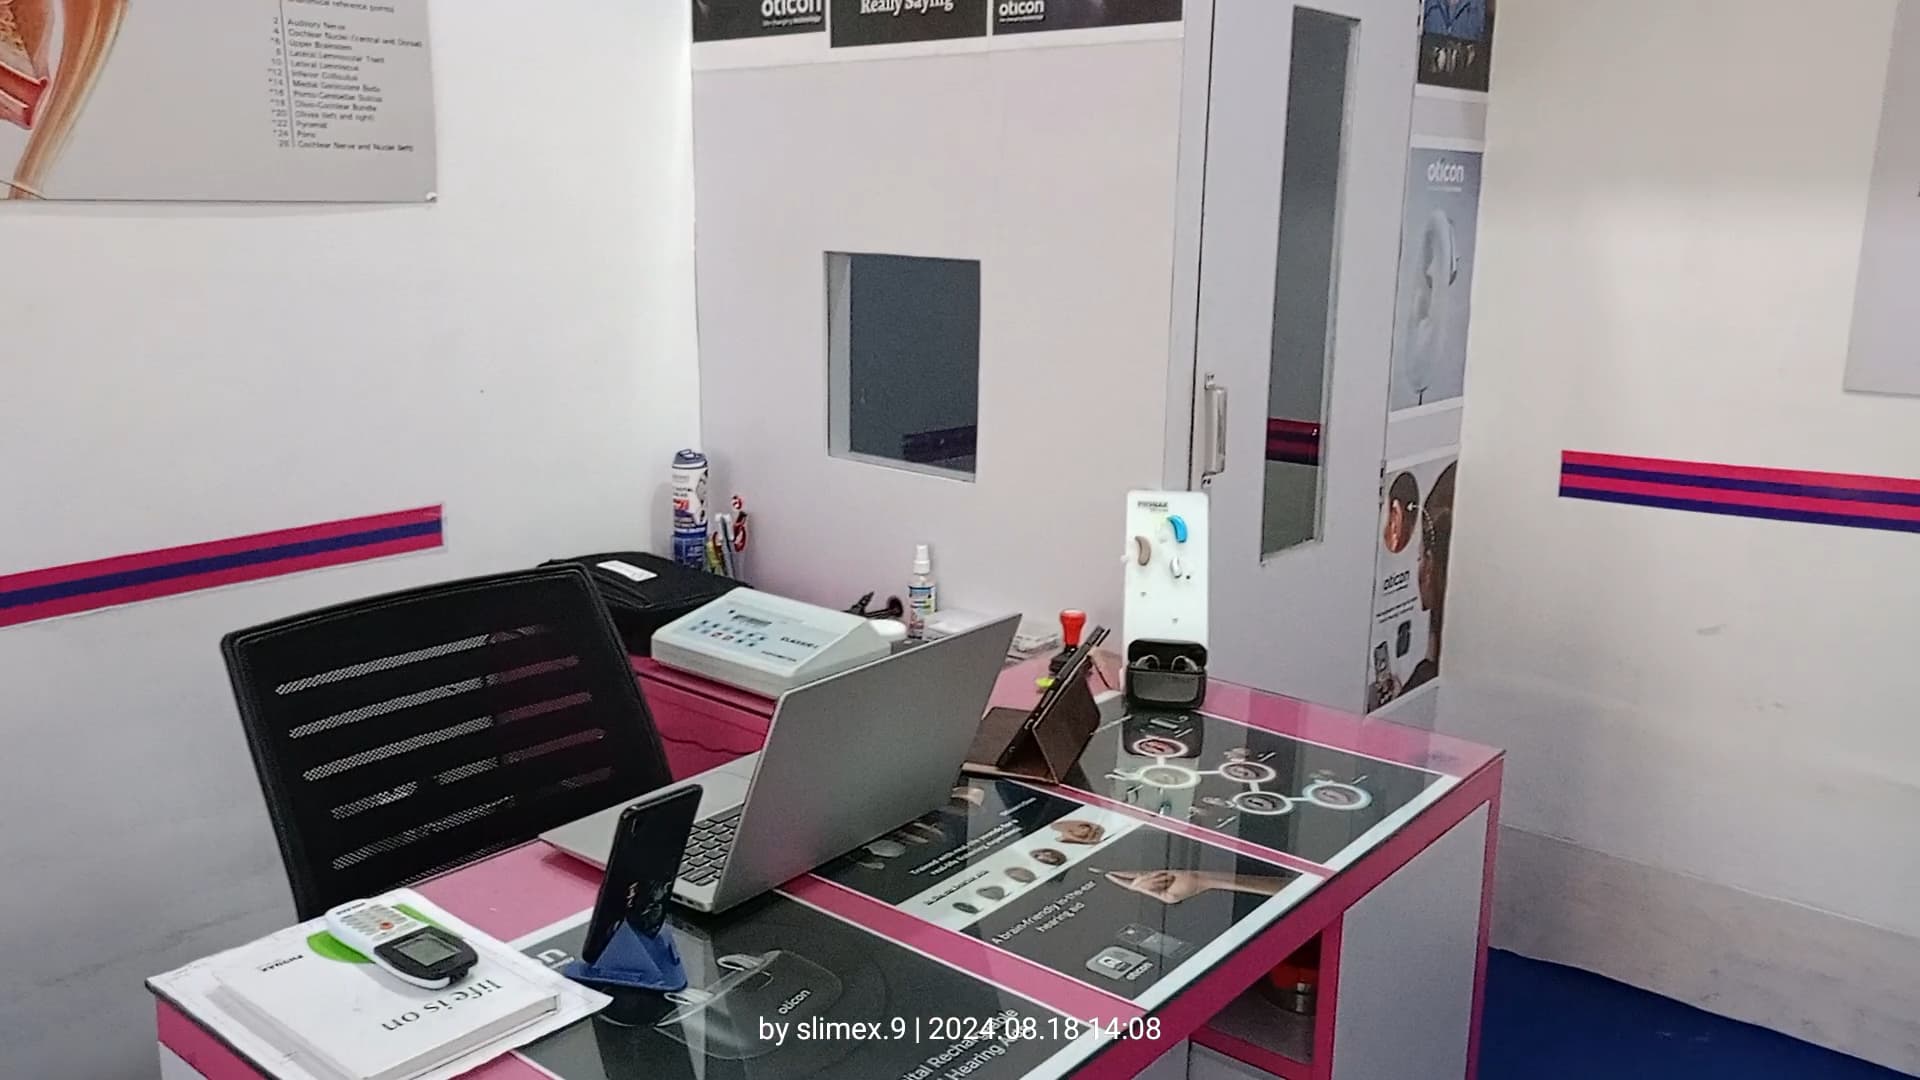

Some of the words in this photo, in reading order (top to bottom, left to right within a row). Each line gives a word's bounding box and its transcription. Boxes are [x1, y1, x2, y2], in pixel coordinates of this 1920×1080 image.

[859, 0, 899, 16] Really
[904, 0, 954, 13] Saying
[998, 0, 1045, 16] oticon
[1427, 158, 1465, 183] oticon
[991, 936, 1003, 945] A
[449, 978, 504, 1002] life
[423, 999, 454, 1013] is
[778, 989, 812, 1015] oticon
[380, 1010, 421, 1032] on
[943, 1043, 1007, 1080] Hearing
